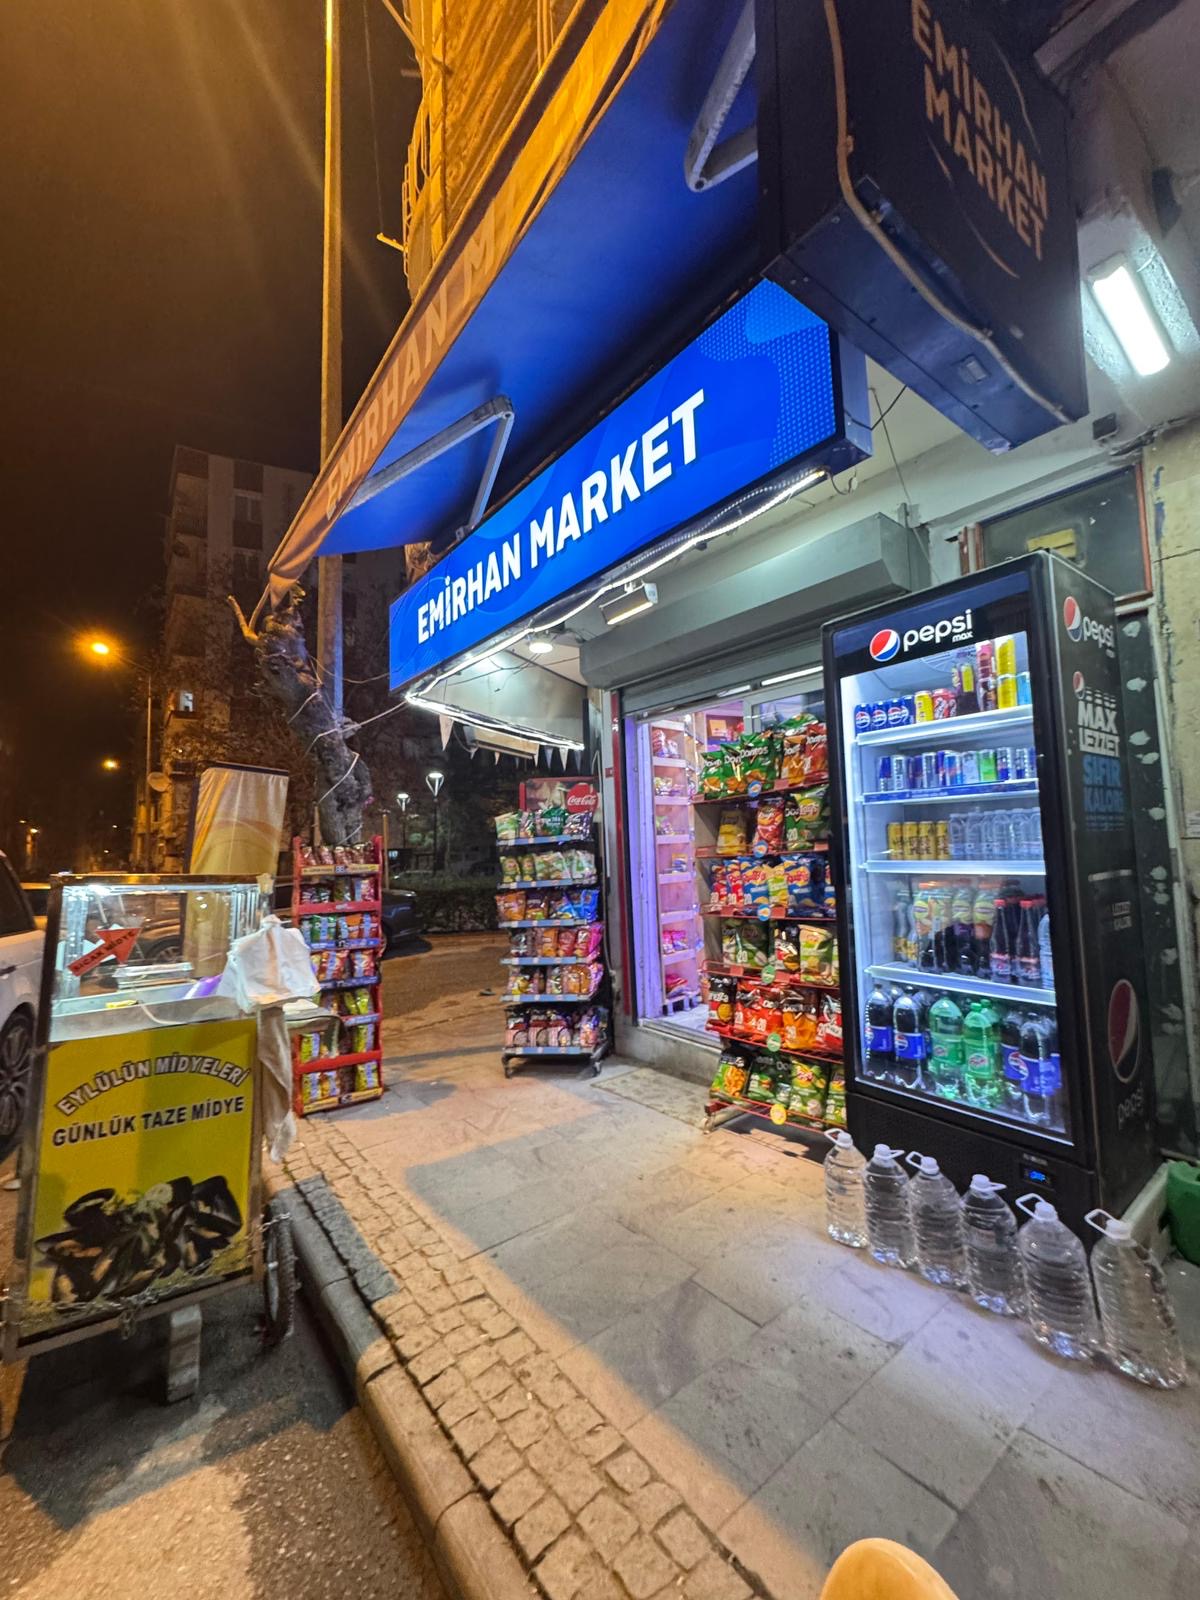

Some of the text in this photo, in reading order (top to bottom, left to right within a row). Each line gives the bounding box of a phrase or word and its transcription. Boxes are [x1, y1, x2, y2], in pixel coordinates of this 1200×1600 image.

[911, 0, 1048, 220] EMİRHAN
[925, 63, 1044, 261] MARKET
[326, 285, 448, 520] EMİRHAN
[417, 388, 705, 645] EMİRHAN MARKET
[903, 608, 973, 652] pepsi
[952, 631, 974, 643] max
[1083, 616, 1115, 649] pepsi
[1078, 700, 1119, 735] MAX
[55, 1052, 250, 1117] EYLÜLÜN MİDYELERİ
[53, 1096, 245, 1147] GÜNLÜK TAZE MİDYE
